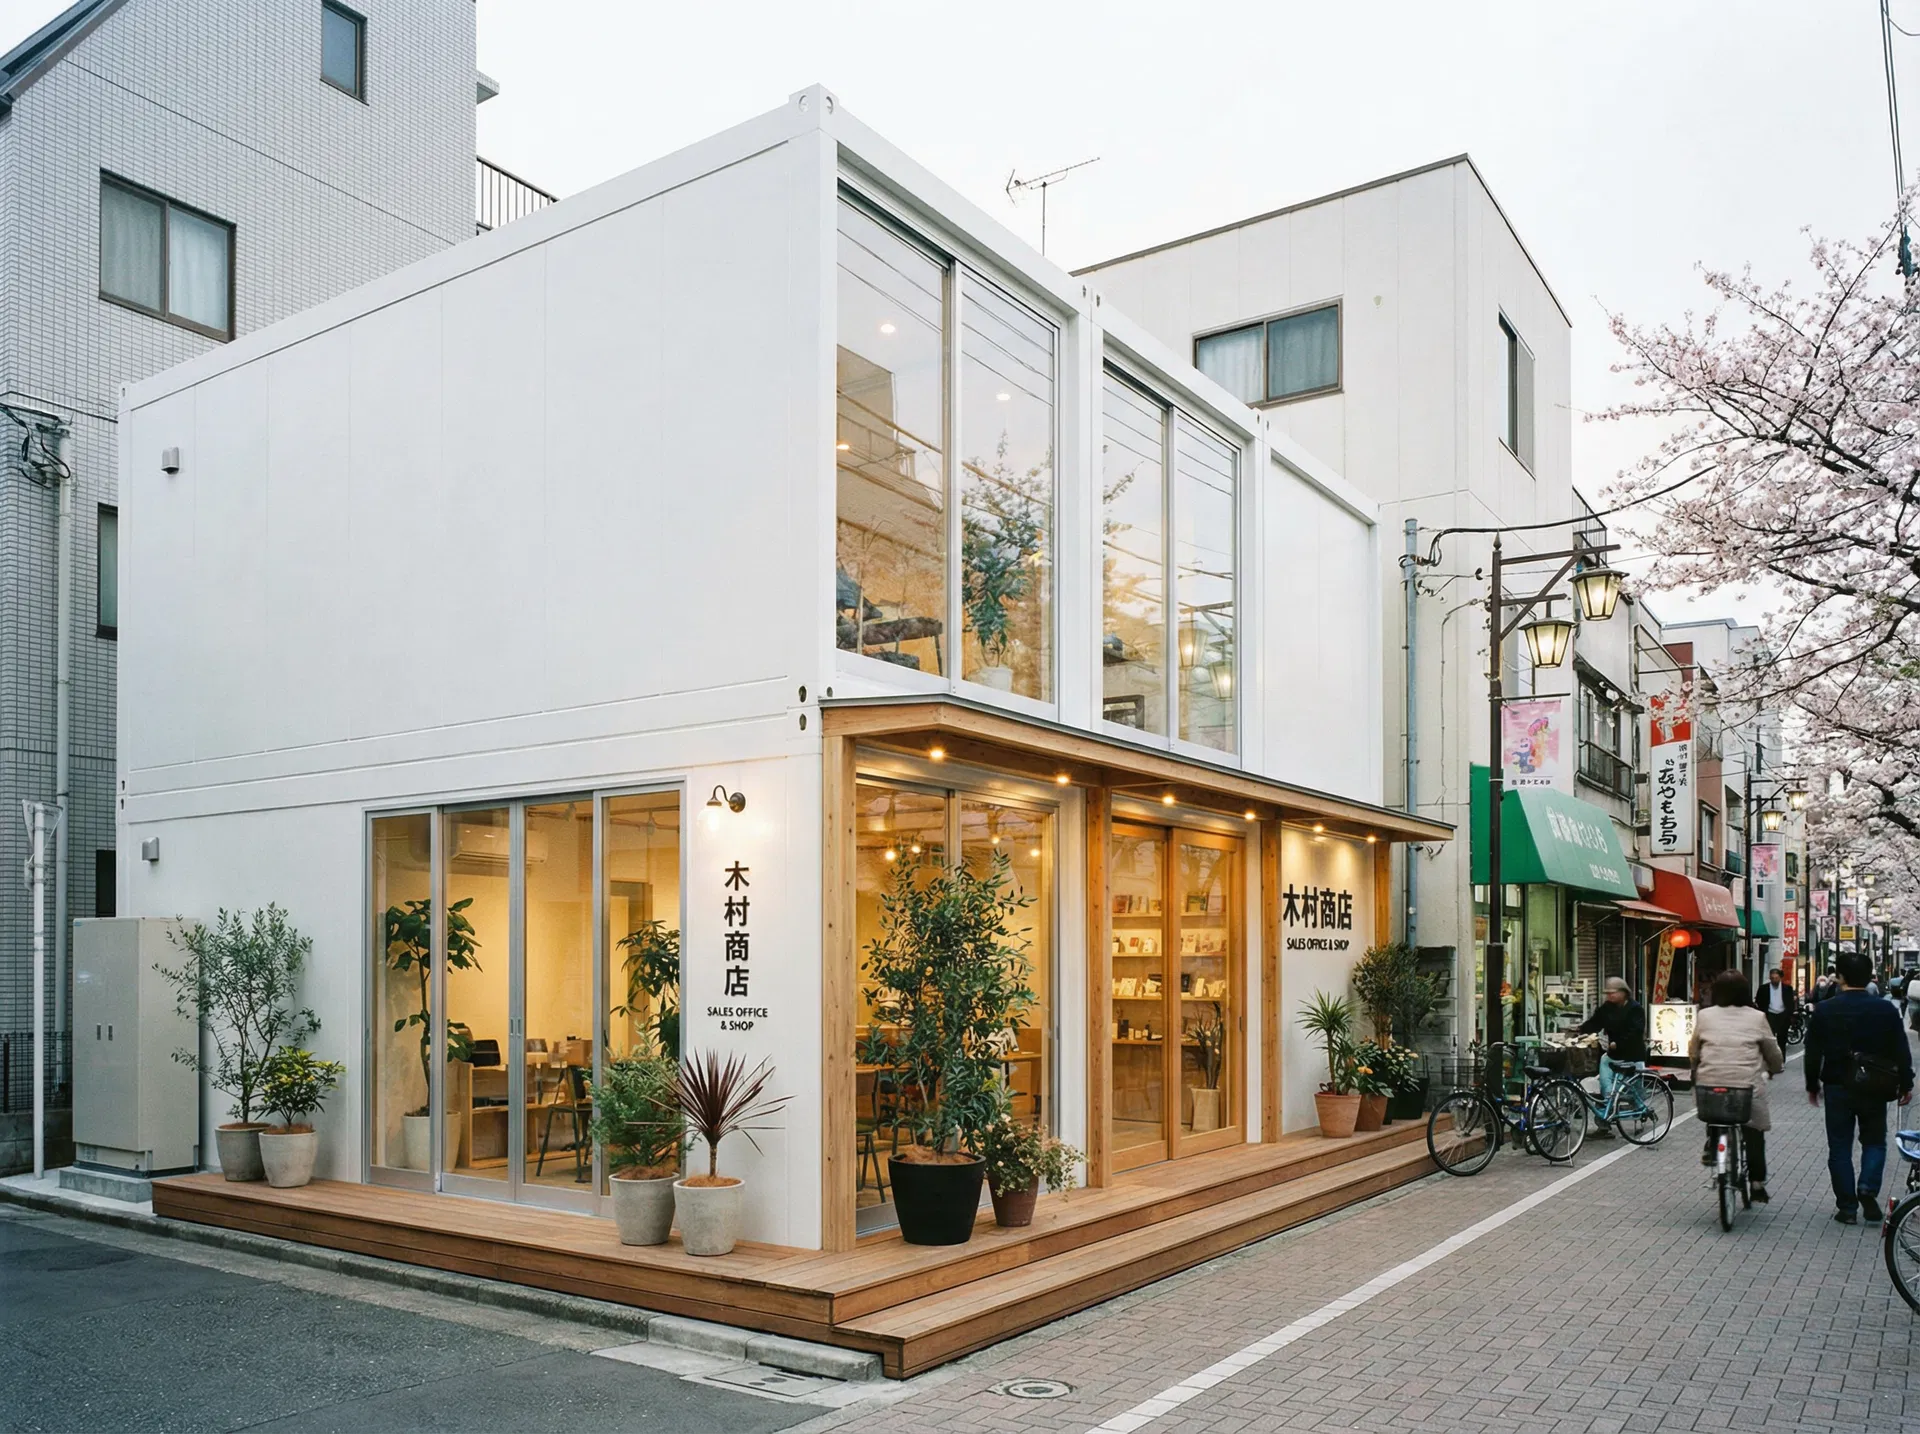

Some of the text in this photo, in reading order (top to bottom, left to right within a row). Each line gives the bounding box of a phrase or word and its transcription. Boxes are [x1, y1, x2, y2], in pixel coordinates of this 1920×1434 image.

[1282, 883, 1353, 930] 木村商店
[724, 861, 750, 997] 木村商店
[1307, 938, 1328, 951] OFFICE
[707, 1006, 768, 1018] SALES OFFICE
[720, 1020, 754, 1032] & SHOP
